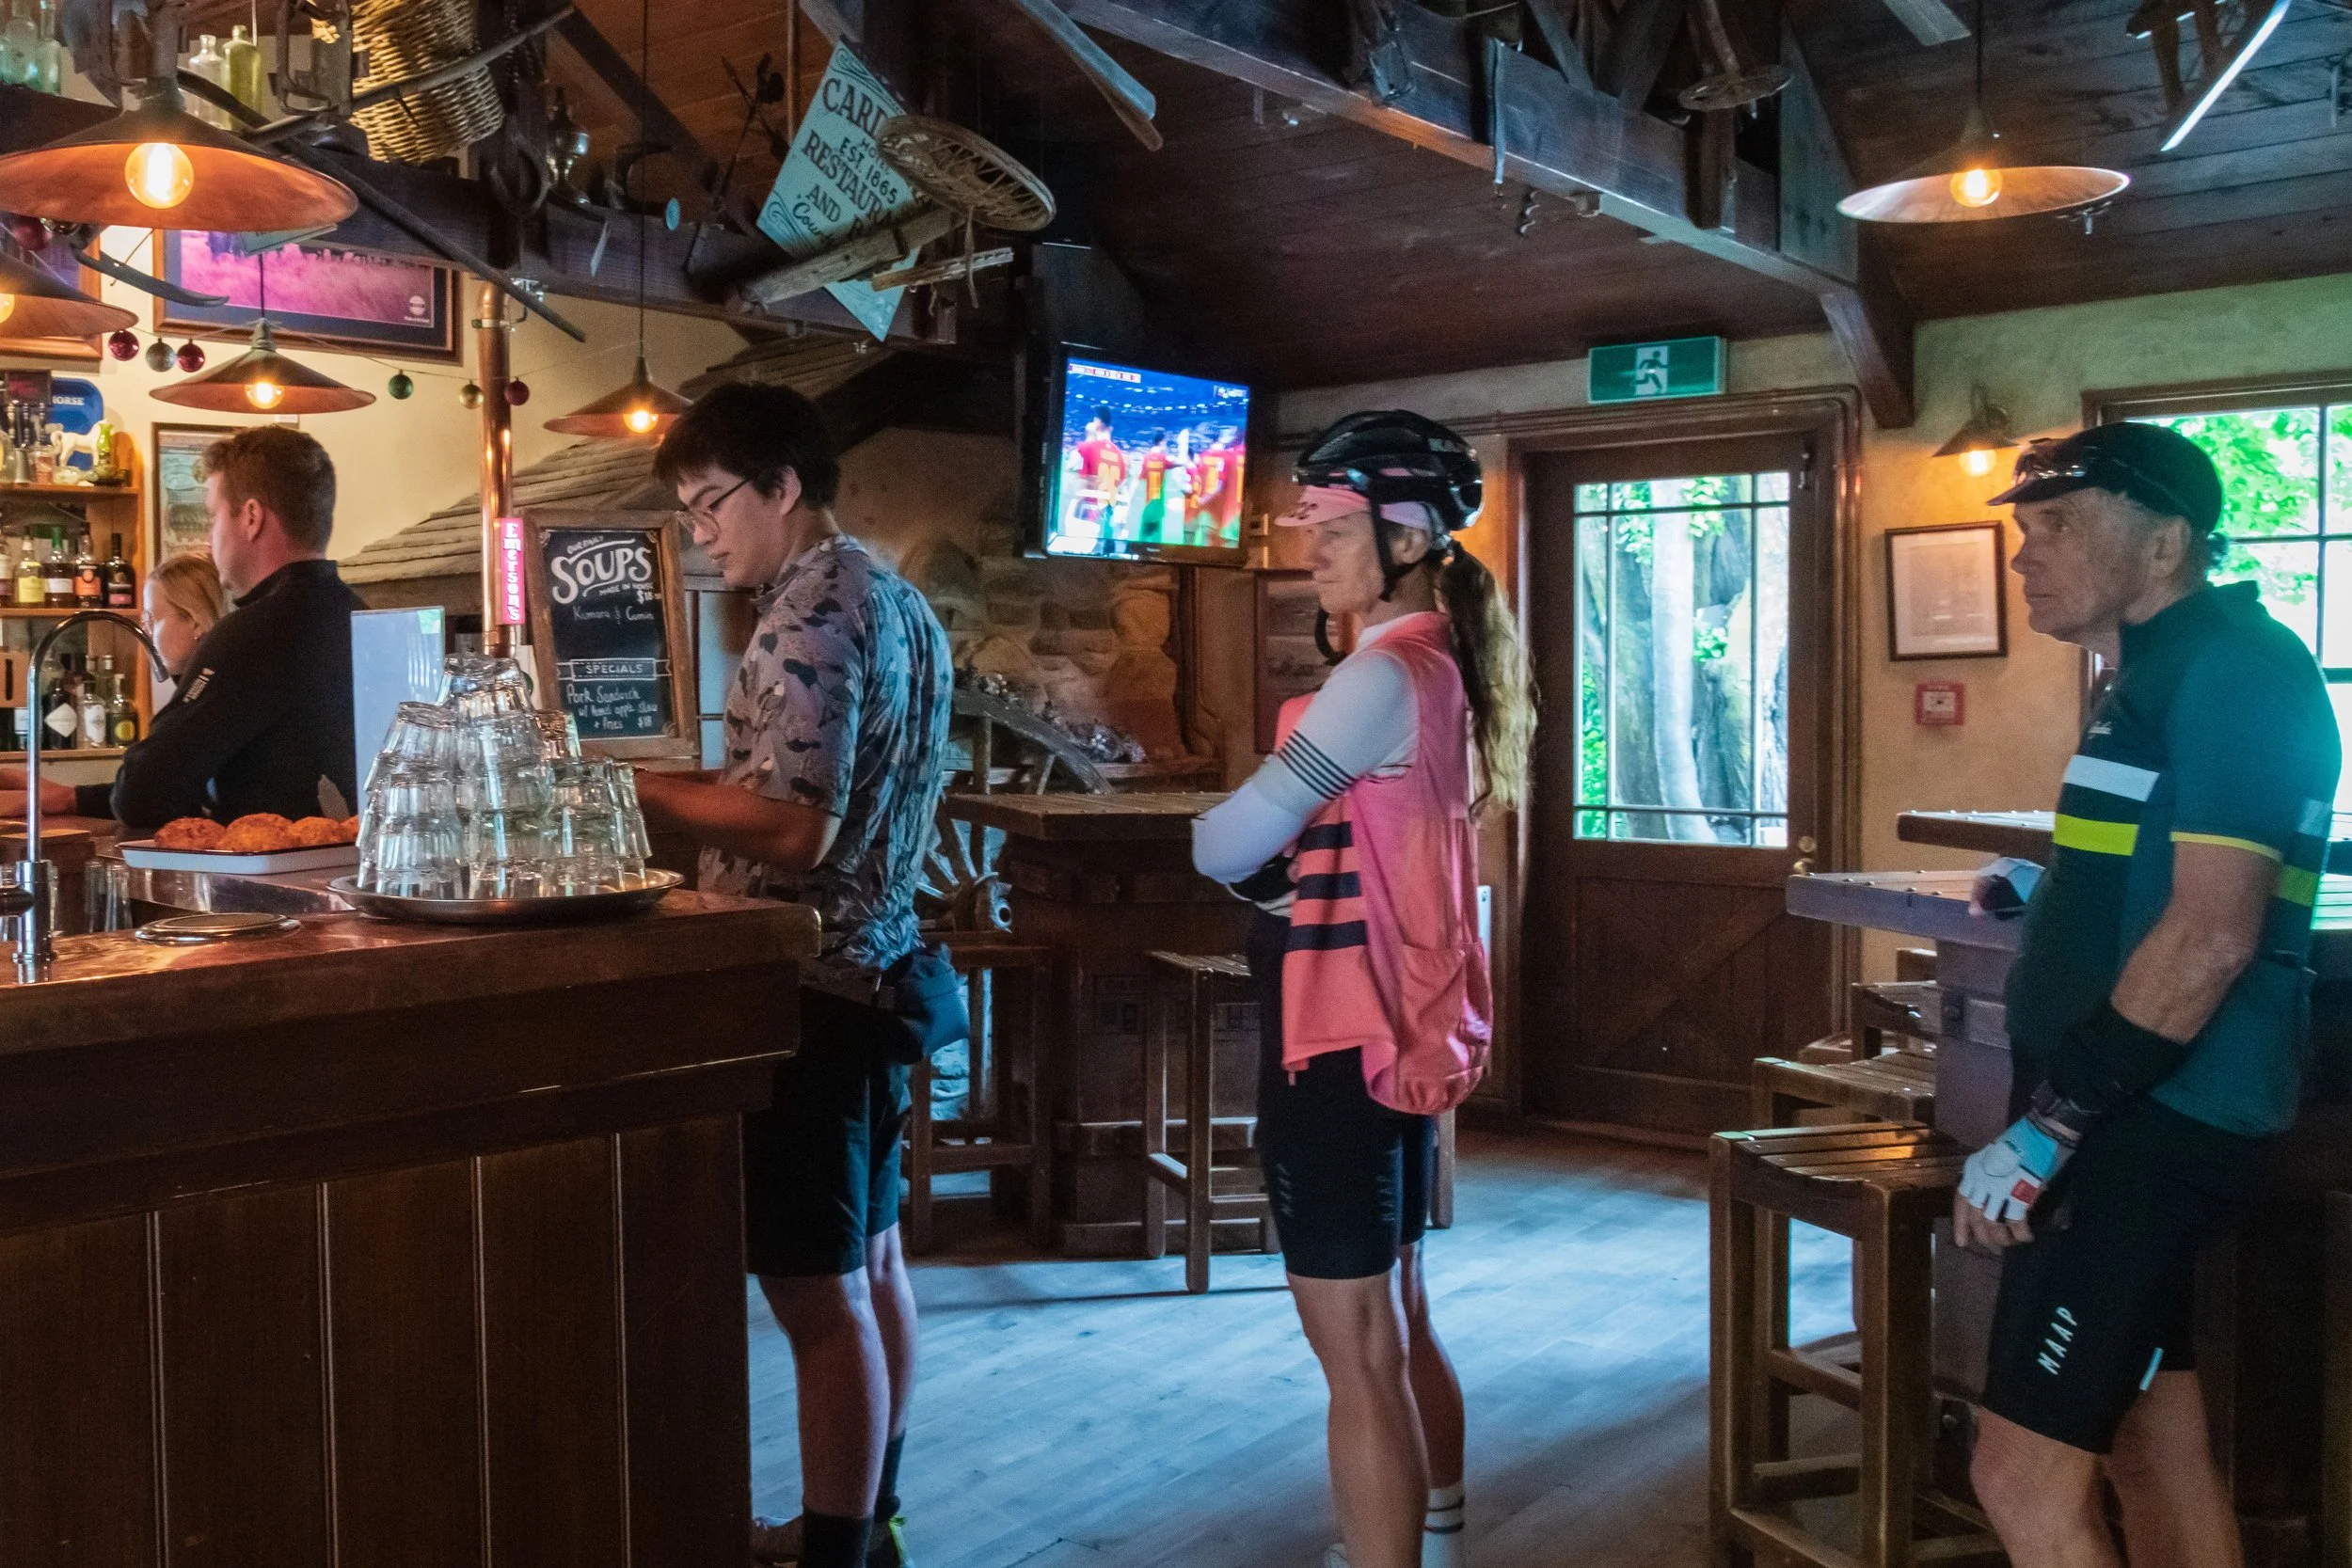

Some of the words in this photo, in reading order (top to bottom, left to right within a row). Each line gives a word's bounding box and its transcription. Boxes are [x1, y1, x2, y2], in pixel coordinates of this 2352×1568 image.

[805, 183, 841, 222] AND
[866, 165, 898, 204] 1865
[550, 542, 652, 605] SOUPS
[585, 663, 644, 674] SPECIALS
[565, 683, 595, 704] Pork
[596, 684, 641, 704] Sandwich
[2036, 1306, 2078, 1376] MAAP
